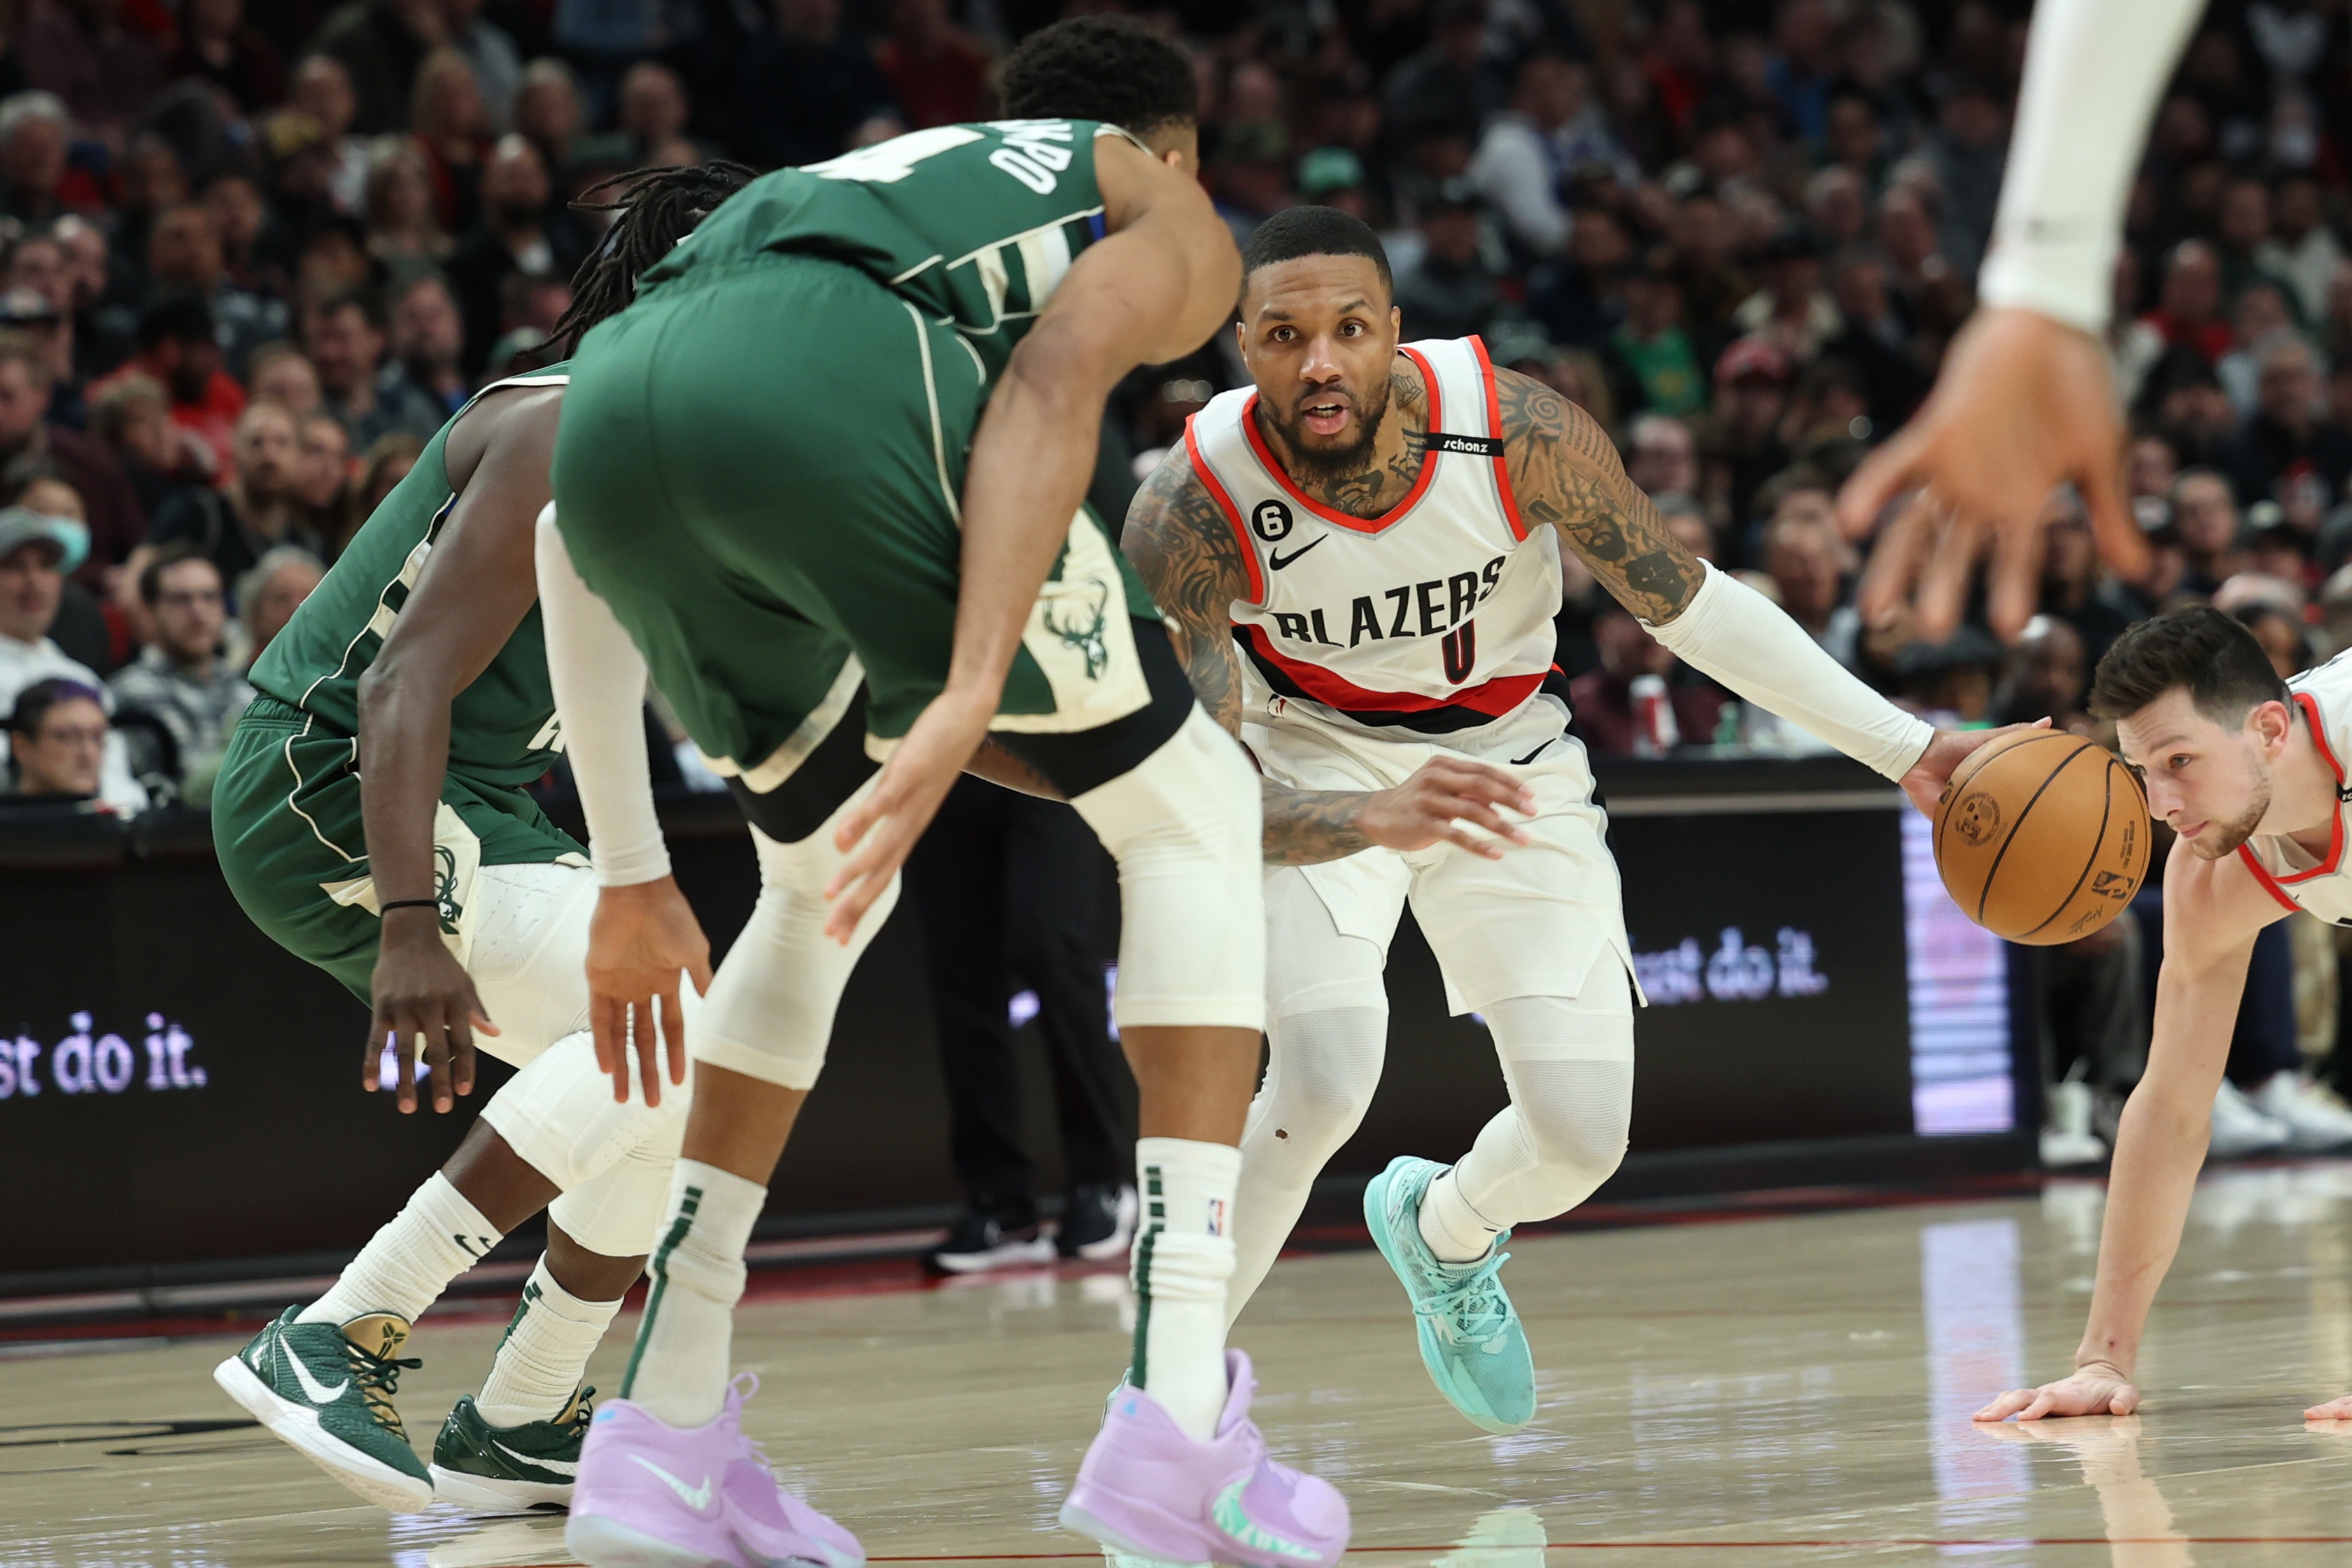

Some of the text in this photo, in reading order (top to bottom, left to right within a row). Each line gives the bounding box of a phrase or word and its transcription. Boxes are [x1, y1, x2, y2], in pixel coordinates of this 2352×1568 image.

[1443, 438, 1488, 453] schonz
[1260, 505, 1286, 537] 6
[1265, 556, 1506, 649] BLAZERS
[1706, 926, 1775, 1001] do
[52, 1010, 134, 1094] do
[143, 1012, 207, 1090] it.
